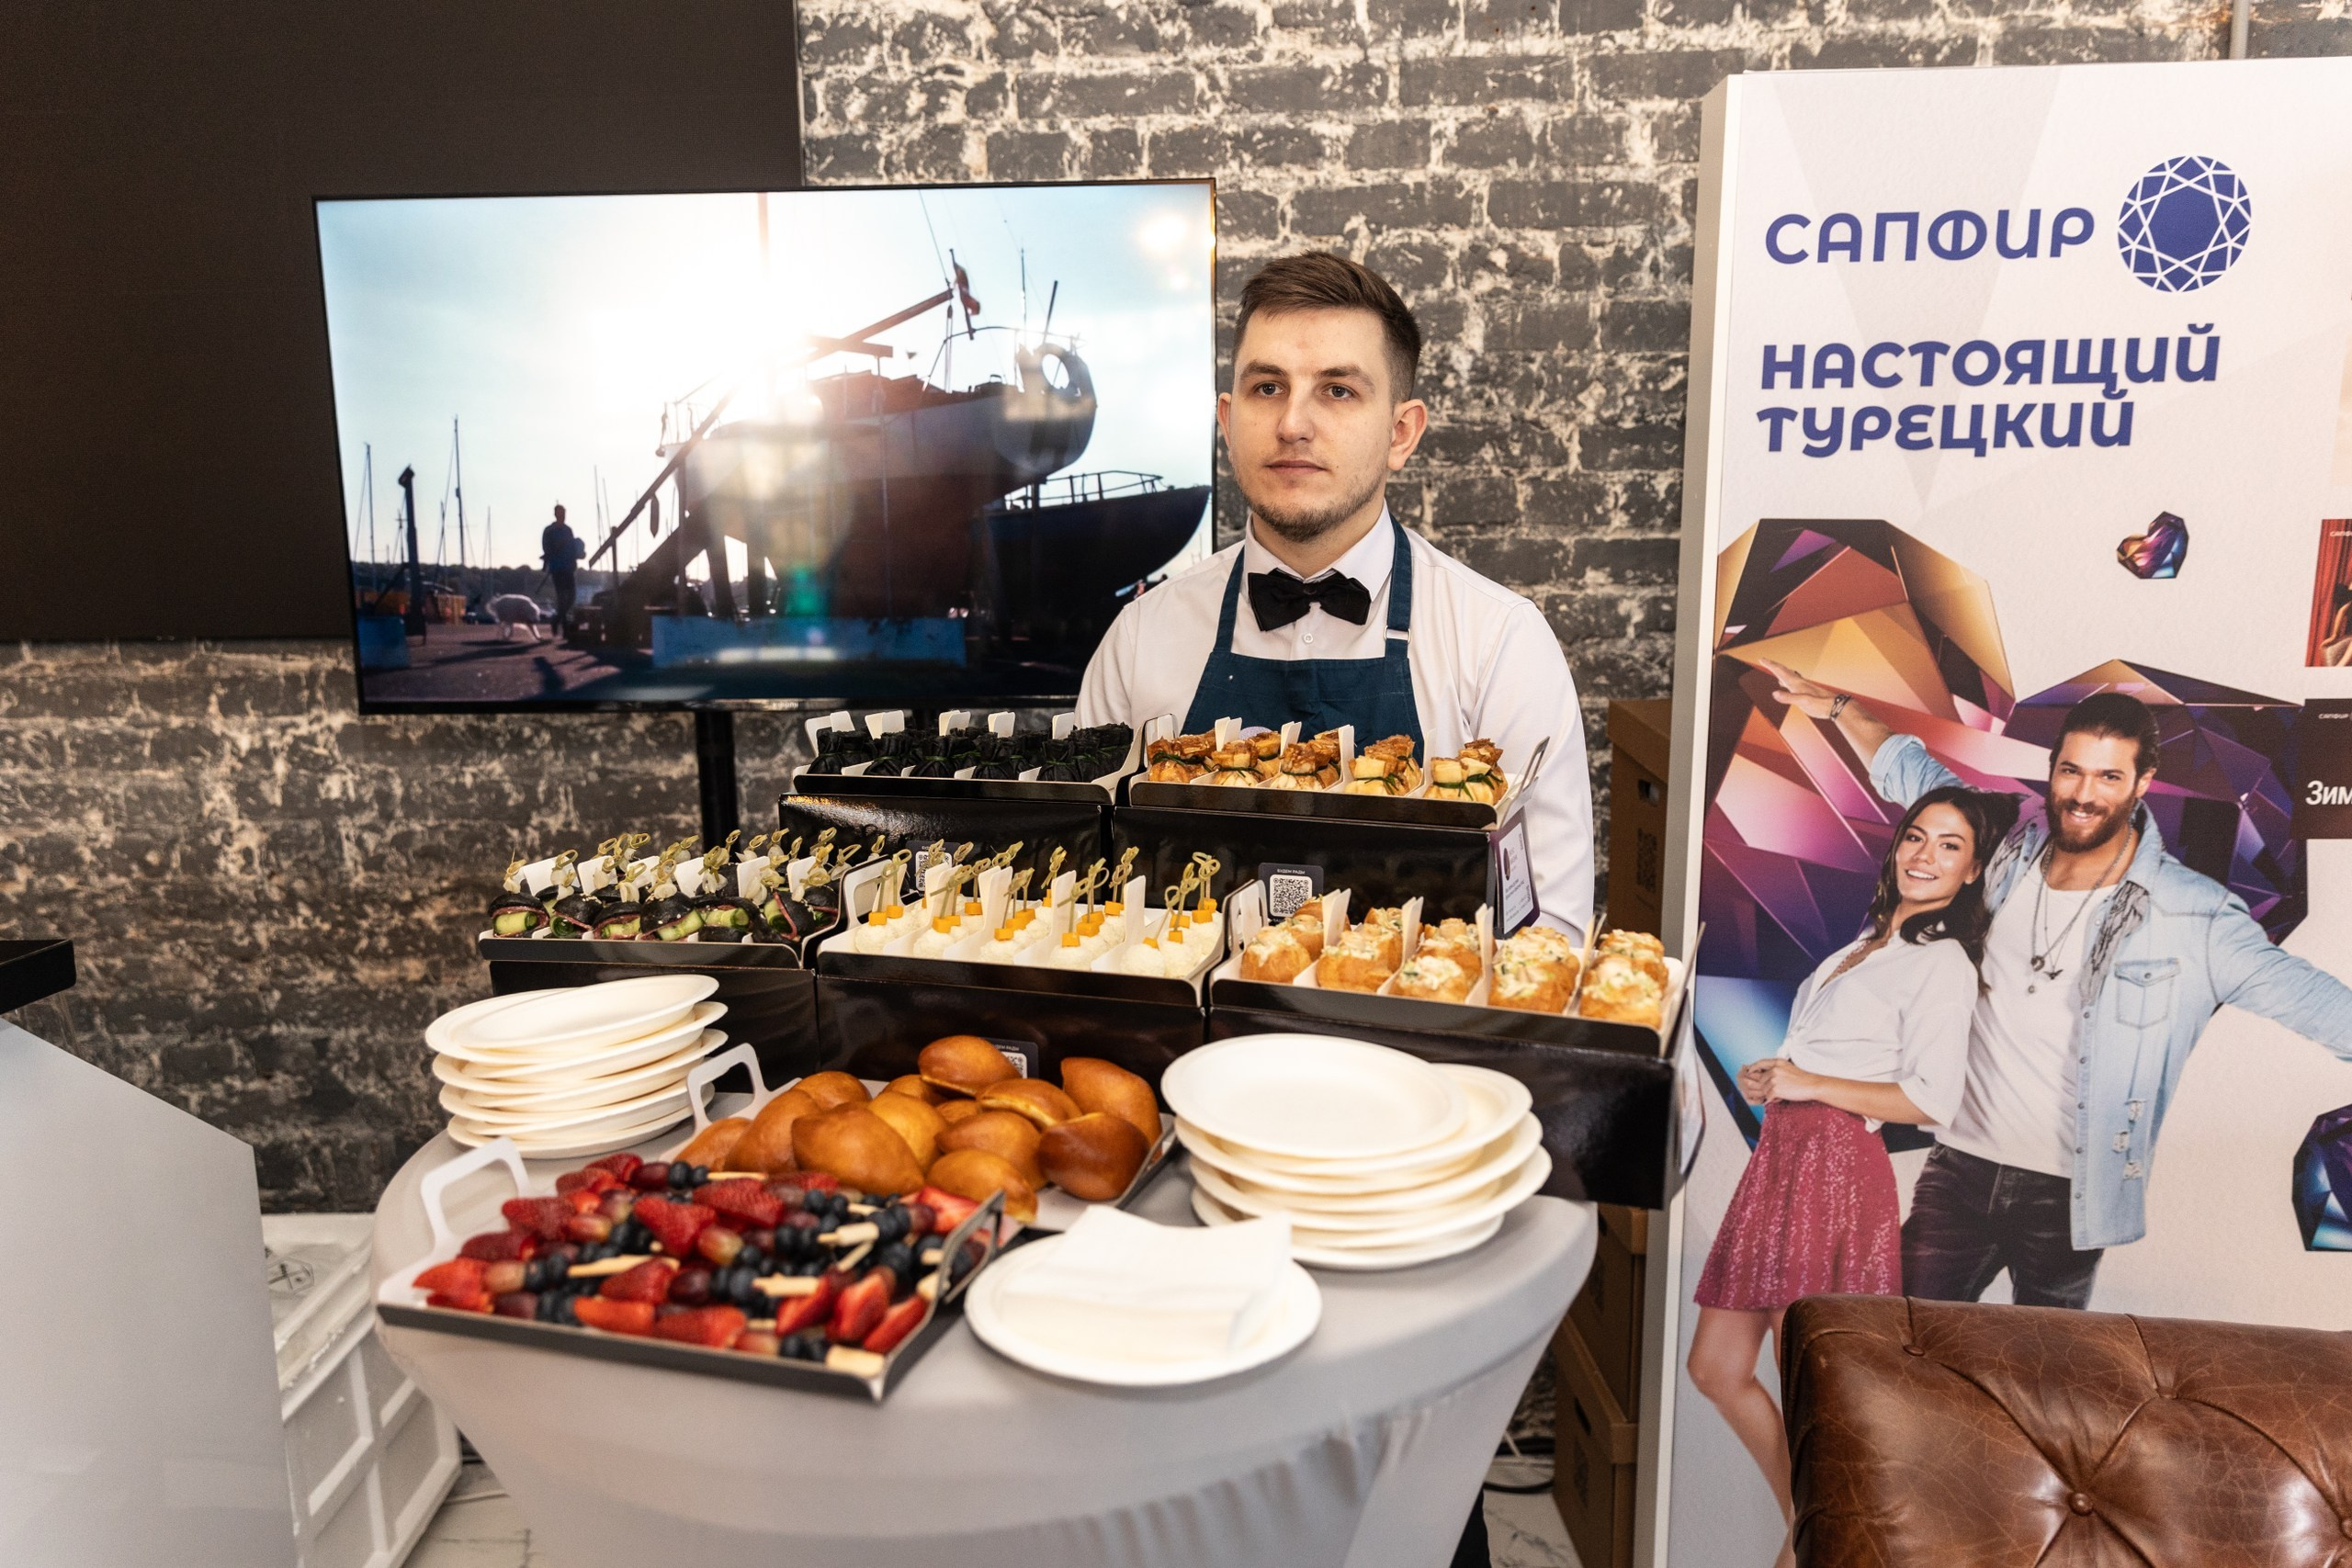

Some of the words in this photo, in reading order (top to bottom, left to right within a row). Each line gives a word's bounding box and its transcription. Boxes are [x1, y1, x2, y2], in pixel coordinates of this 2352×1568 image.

[1765, 208, 2095, 265] САПФИР
[1760, 323, 2222, 392] НАСТОЯЩИЙ
[1756, 389, 2135, 458] ТУРЕЦКИЙ
